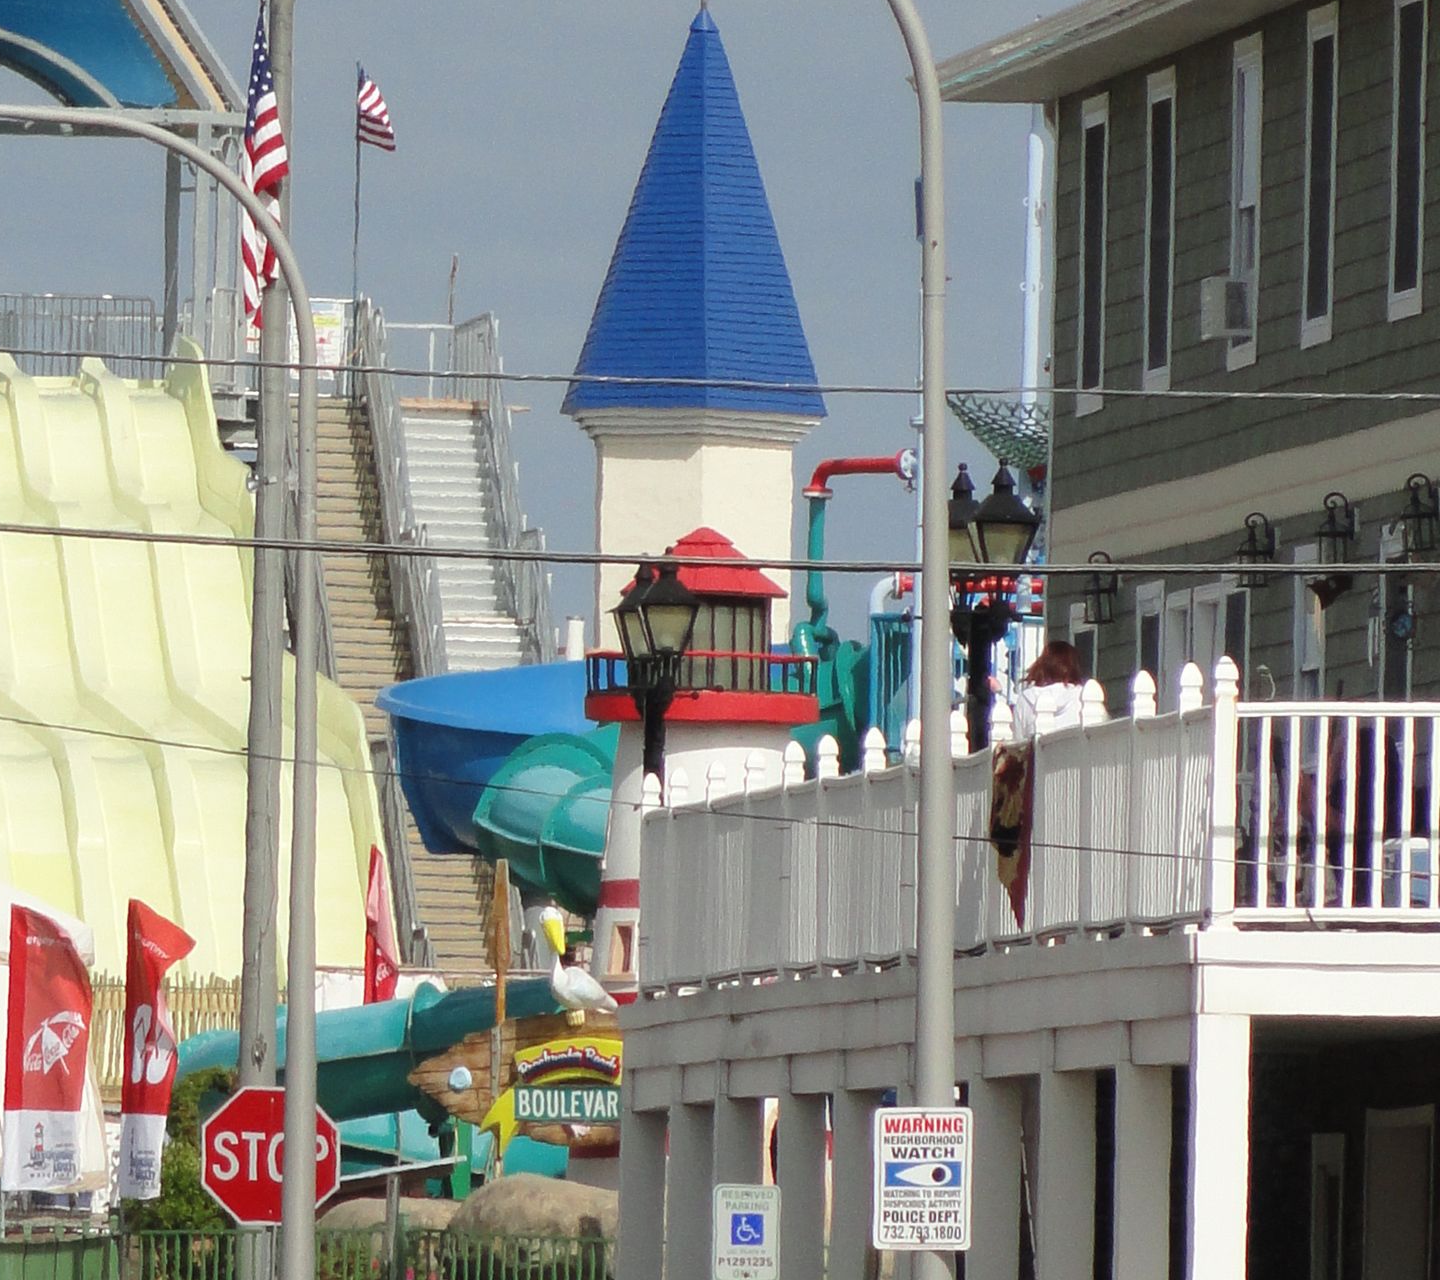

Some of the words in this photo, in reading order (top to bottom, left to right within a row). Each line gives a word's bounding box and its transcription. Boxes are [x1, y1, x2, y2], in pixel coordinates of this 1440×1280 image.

[884, 1117, 964, 1134] WARNING
[884, 1135, 964, 1145] NEIGHBORHOOD
[892, 1147, 955, 1159] WATCH
[721, 1190, 774, 1199] RESERVED
[725, 1201, 769, 1211] PARKING
[883, 1211, 925, 1223] POLICE
[928, 1211, 961, 1223] DEPT.
[883, 1225, 961, 1240] 732.793.1800
